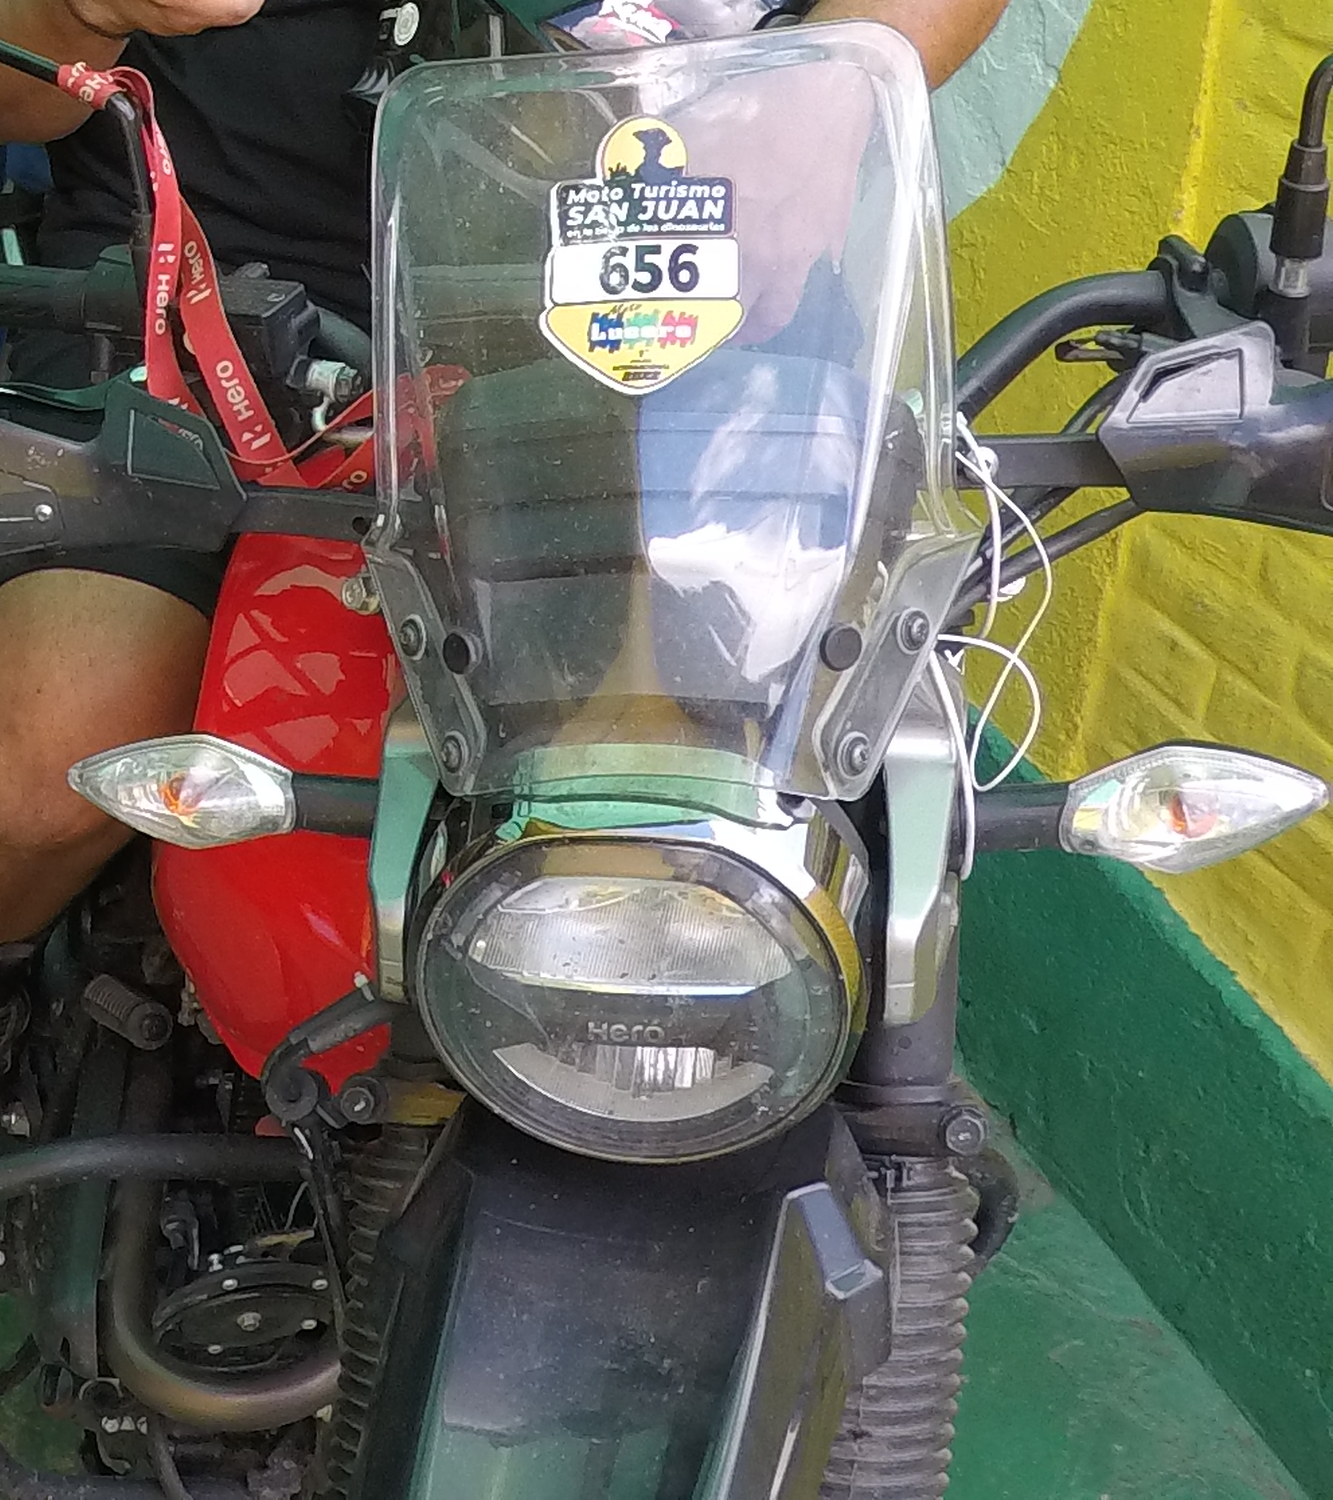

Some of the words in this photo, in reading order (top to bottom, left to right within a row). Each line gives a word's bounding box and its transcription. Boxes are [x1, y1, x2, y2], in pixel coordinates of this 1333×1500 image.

[566, 186, 625, 205] Moto
[632, 180, 726, 199] Turismo
[566, 202, 629, 226] SAN
[638, 200, 725, 221] JUAN
[183, 240, 206, 285] Hero
[599, 243, 700, 295] 656
[154, 274, 172, 336] Hero
[215, 360, 255, 422] Hero
[587, 1021, 665, 1043] Hero
